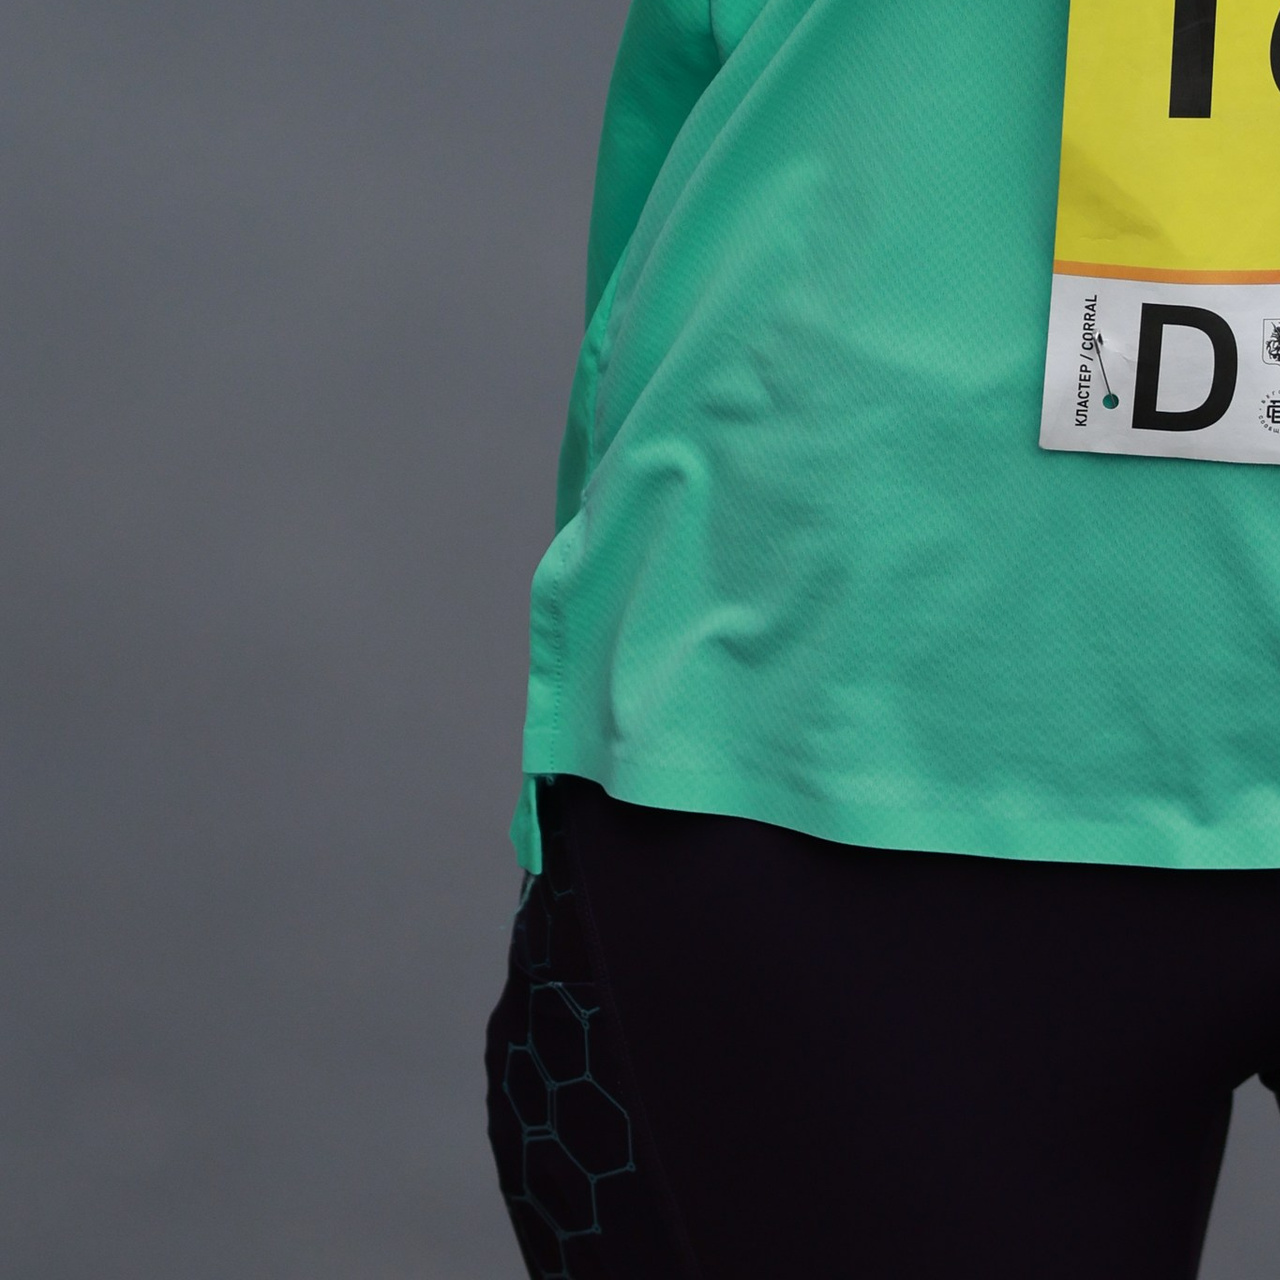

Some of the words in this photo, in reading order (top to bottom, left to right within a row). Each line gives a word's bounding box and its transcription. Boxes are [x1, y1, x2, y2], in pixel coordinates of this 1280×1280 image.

[1081, 294, 1097, 351] CORRAL
[1075, 364, 1091, 426] КЛАСТЕР
[1132, 302, 1238, 432] D
